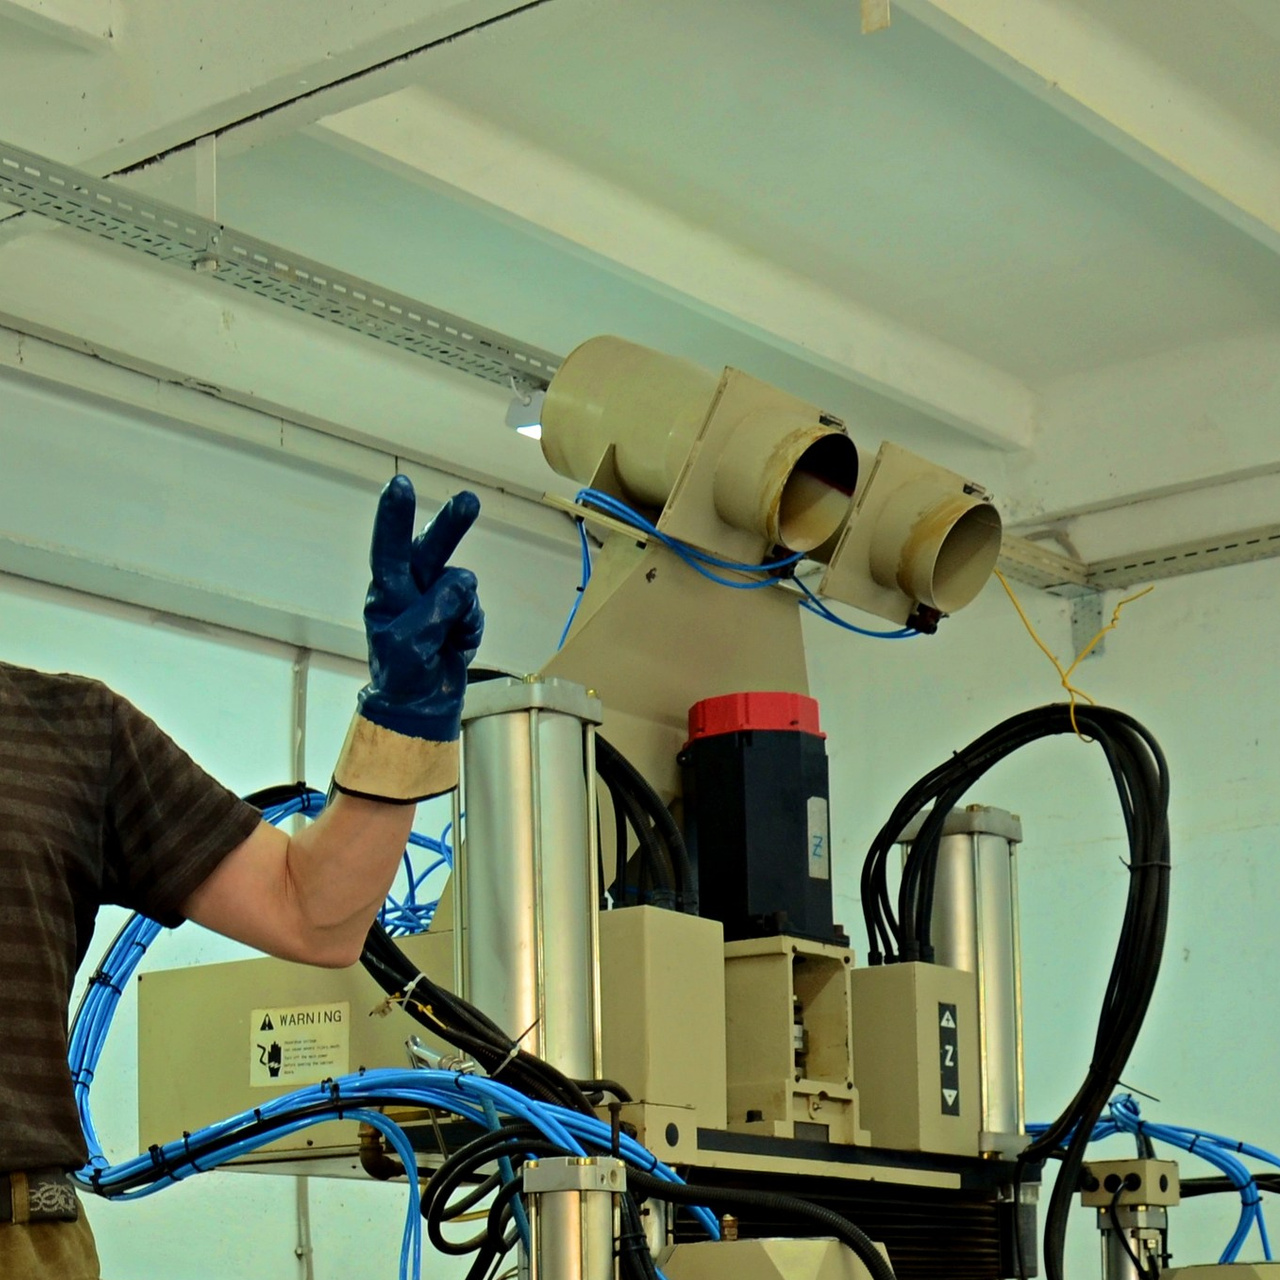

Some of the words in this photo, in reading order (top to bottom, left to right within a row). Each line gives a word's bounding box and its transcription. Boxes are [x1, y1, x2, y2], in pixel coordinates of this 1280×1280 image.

[811, 834, 823, 858] Z
[280, 1010, 342, 1027] WARNING
[944, 1044, 954, 1068] Z
